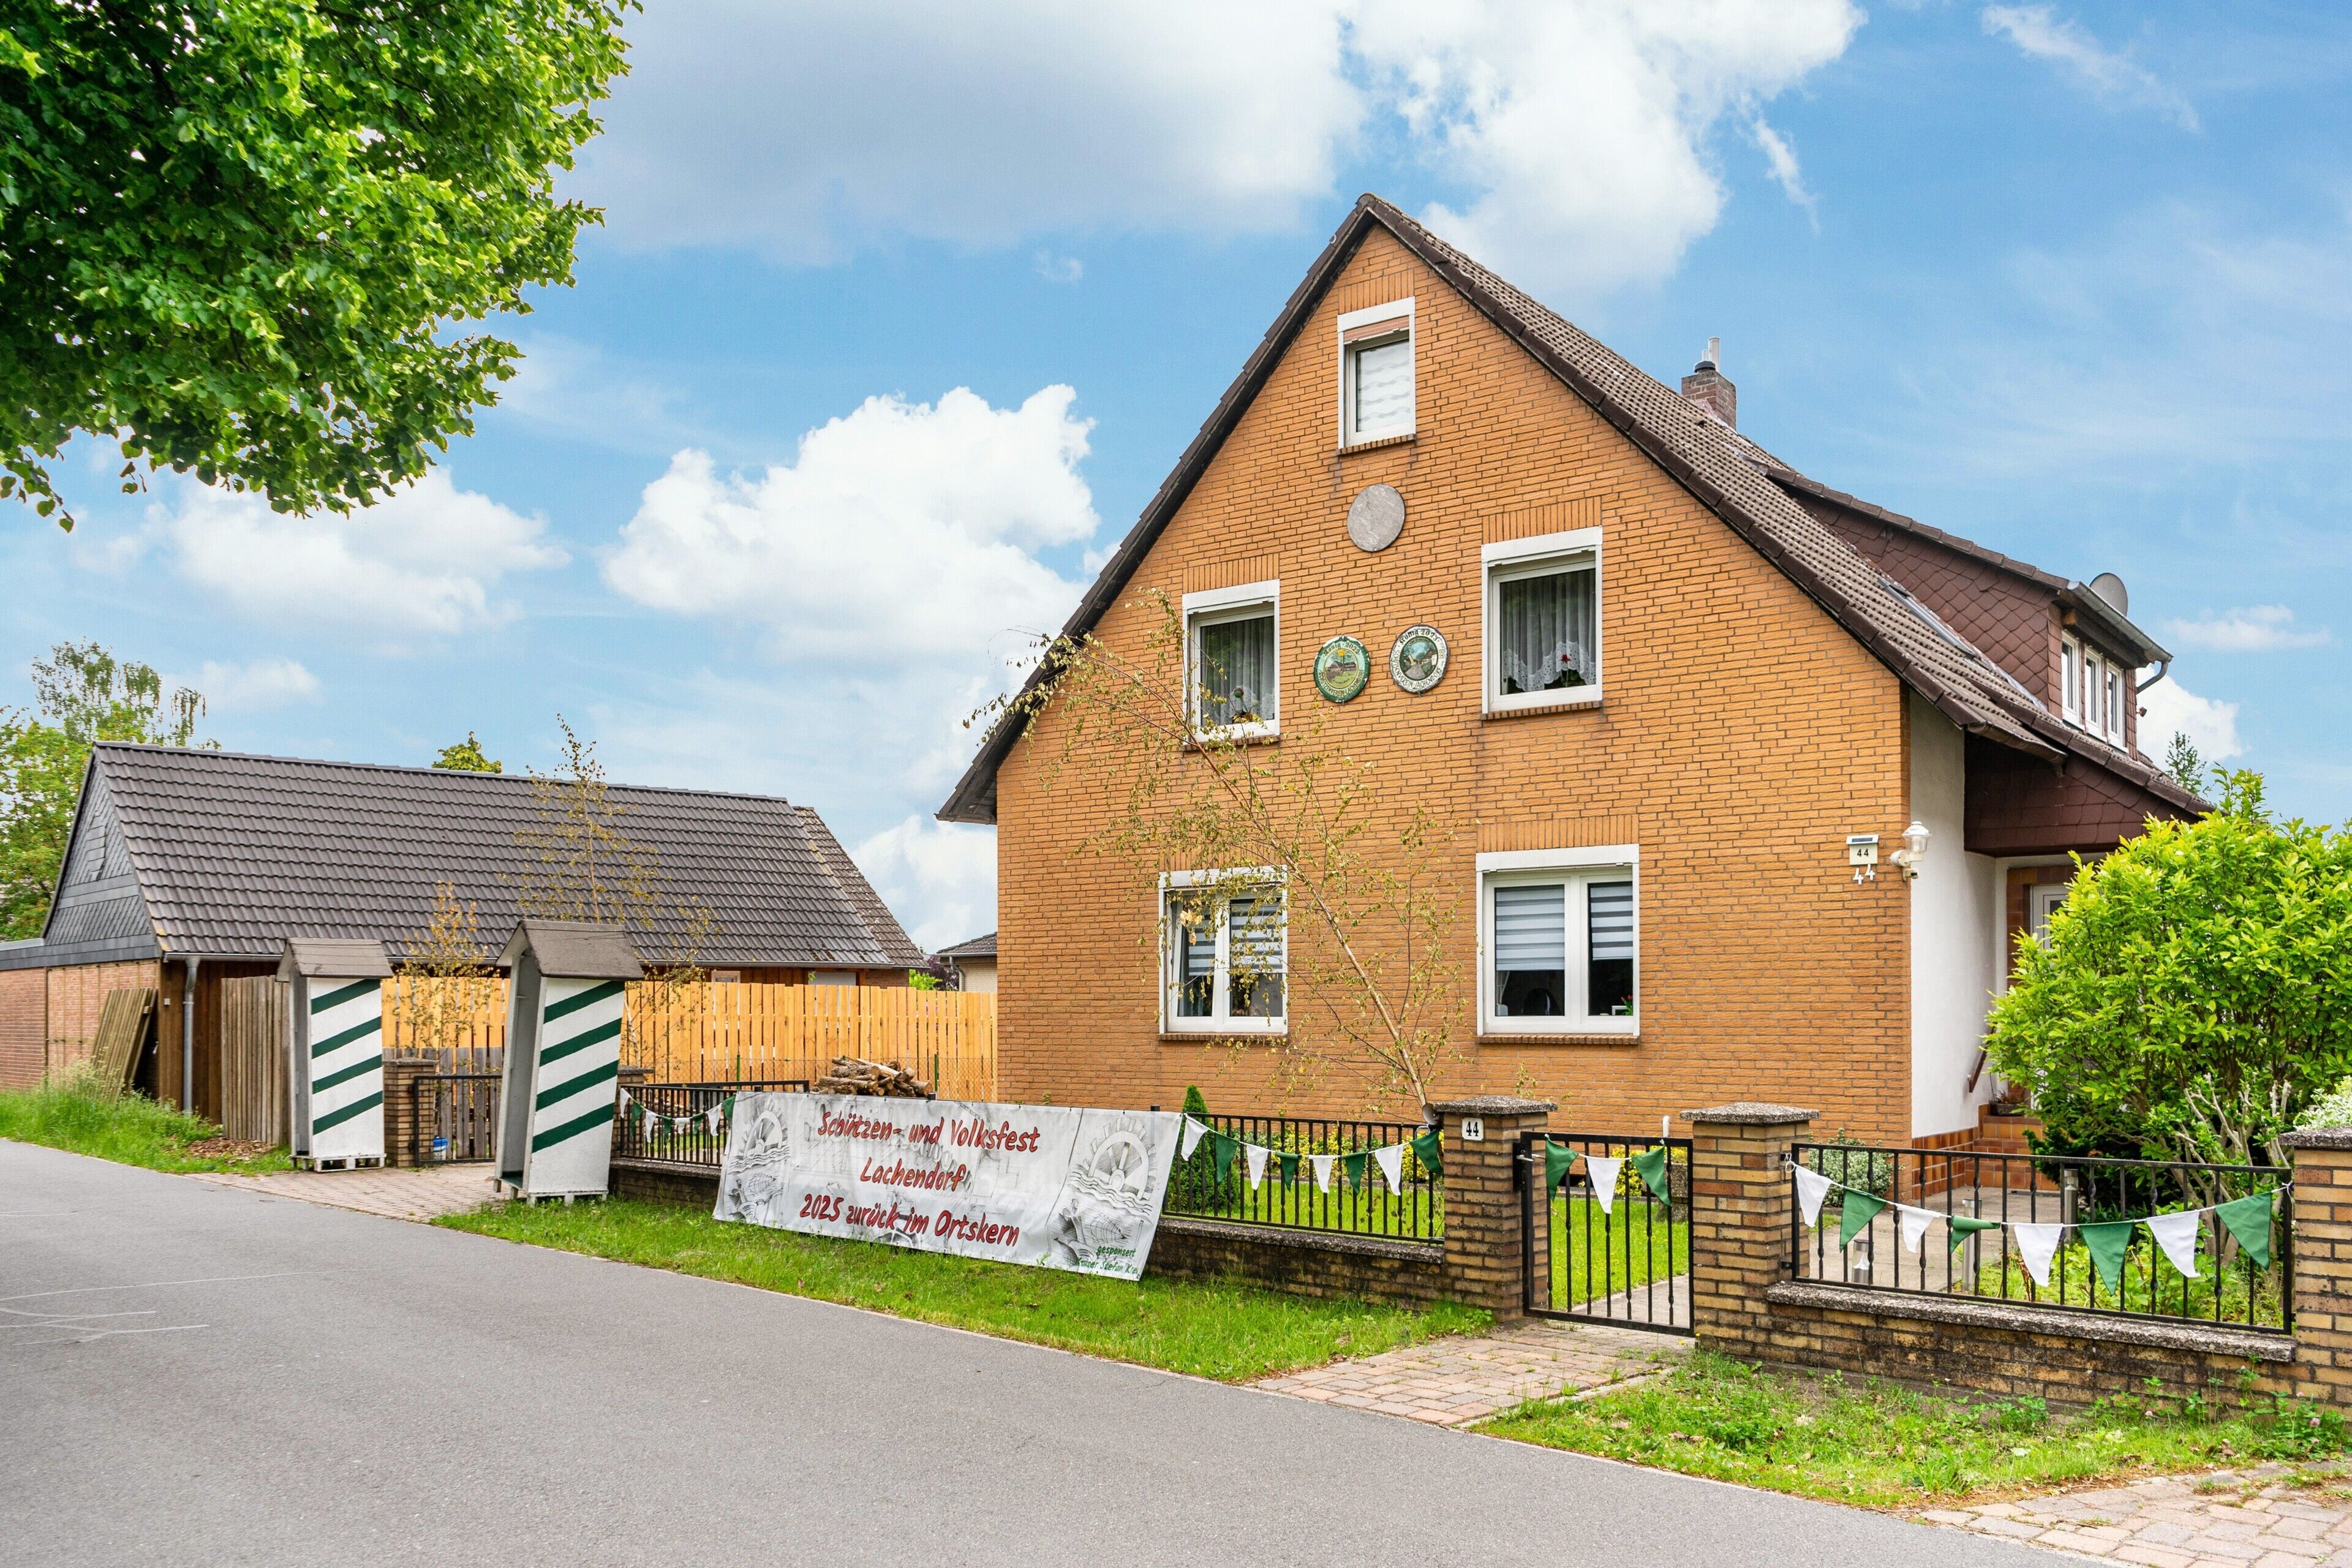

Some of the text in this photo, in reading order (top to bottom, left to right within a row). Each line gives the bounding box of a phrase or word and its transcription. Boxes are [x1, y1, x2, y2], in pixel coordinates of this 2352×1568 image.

[1420, 628, 1439, 641] 2023
[1345, 642, 1360, 654] 2022
[1857, 848, 1869, 858] 44
[1853, 864, 1875, 886] 44
[817, 1111, 1041, 1153] Schützen- und Volksfest
[1466, 1121, 1479, 1137] 44
[860, 1156, 967, 1192] Lachendorf
[799, 1193, 1020, 1247] 2025 zurück im Ortskern
[1096, 1245, 1136, 1257] gesponsert
[1099, 1260, 1124, 1272] Stefan
